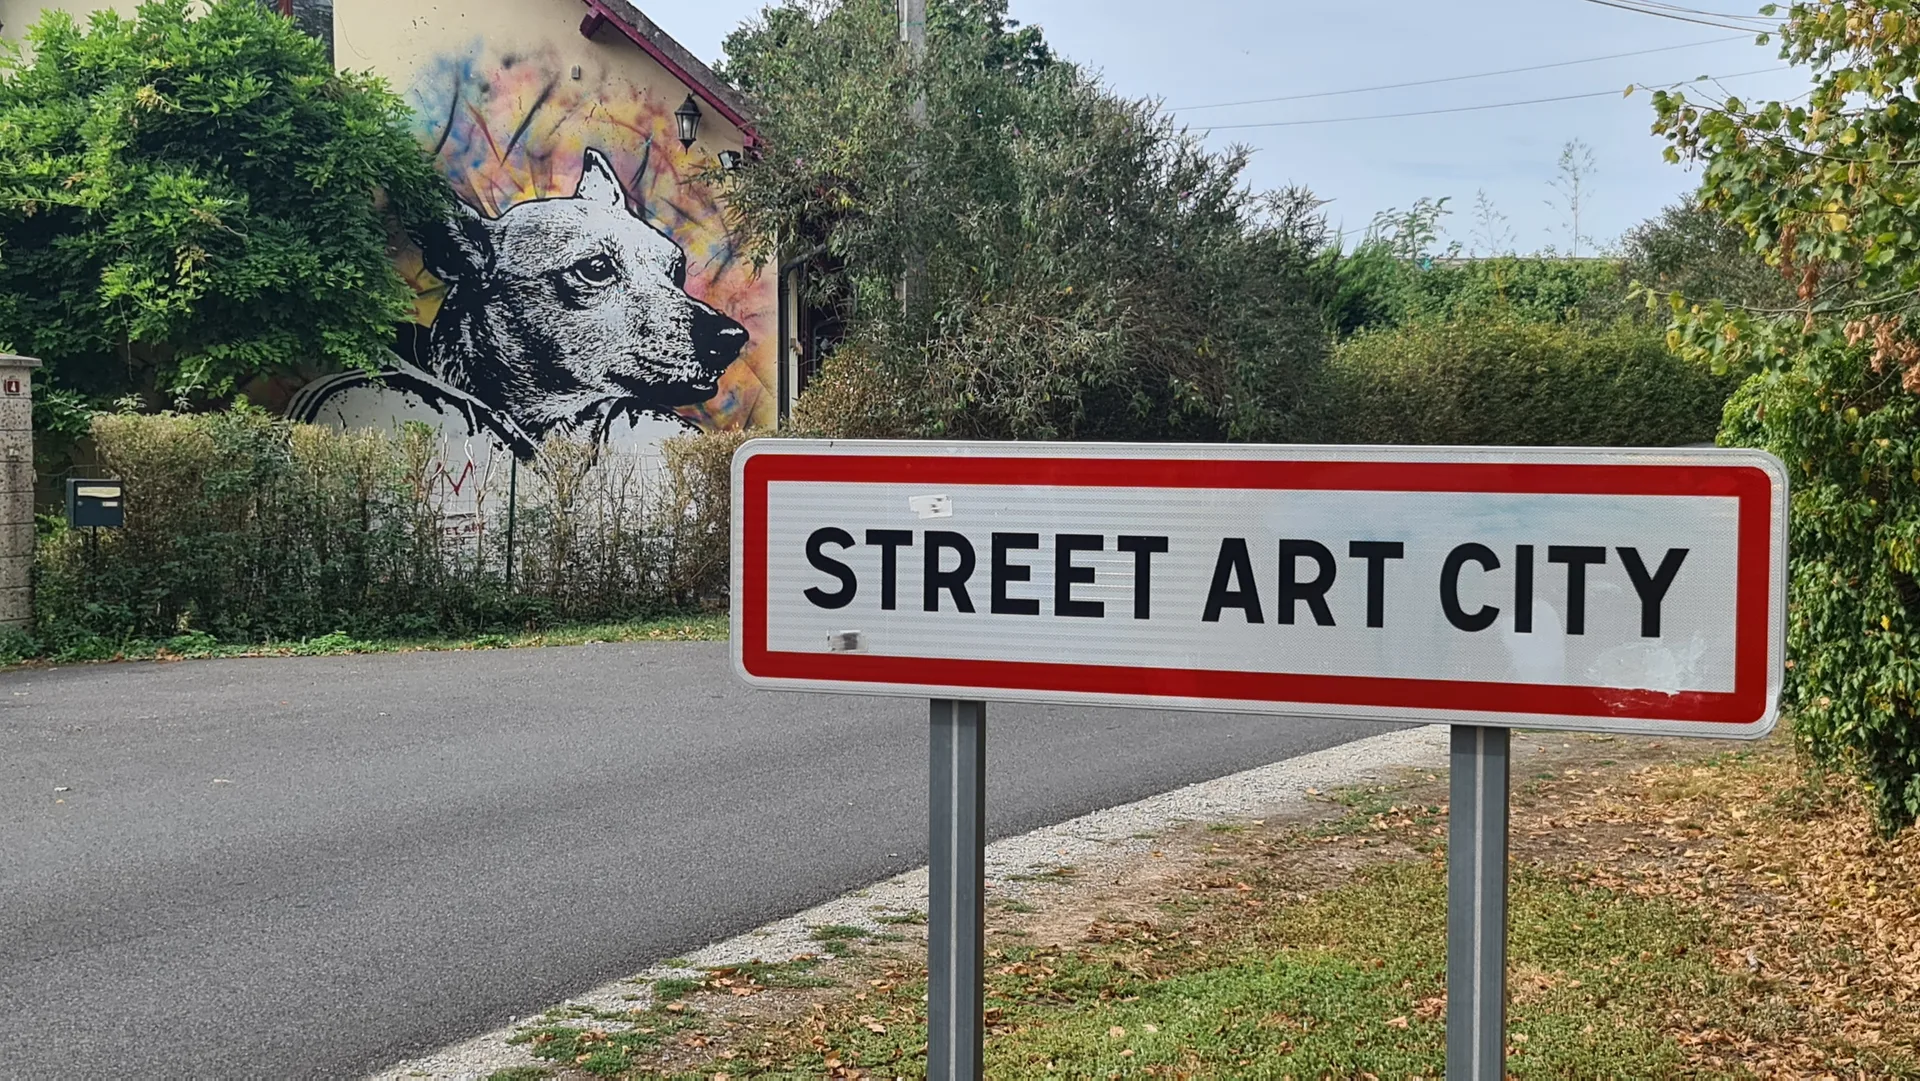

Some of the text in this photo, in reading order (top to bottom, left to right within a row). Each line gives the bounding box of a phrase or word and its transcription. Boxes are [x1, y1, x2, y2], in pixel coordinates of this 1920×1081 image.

[804, 527, 1689, 637] STREET ART CITY
